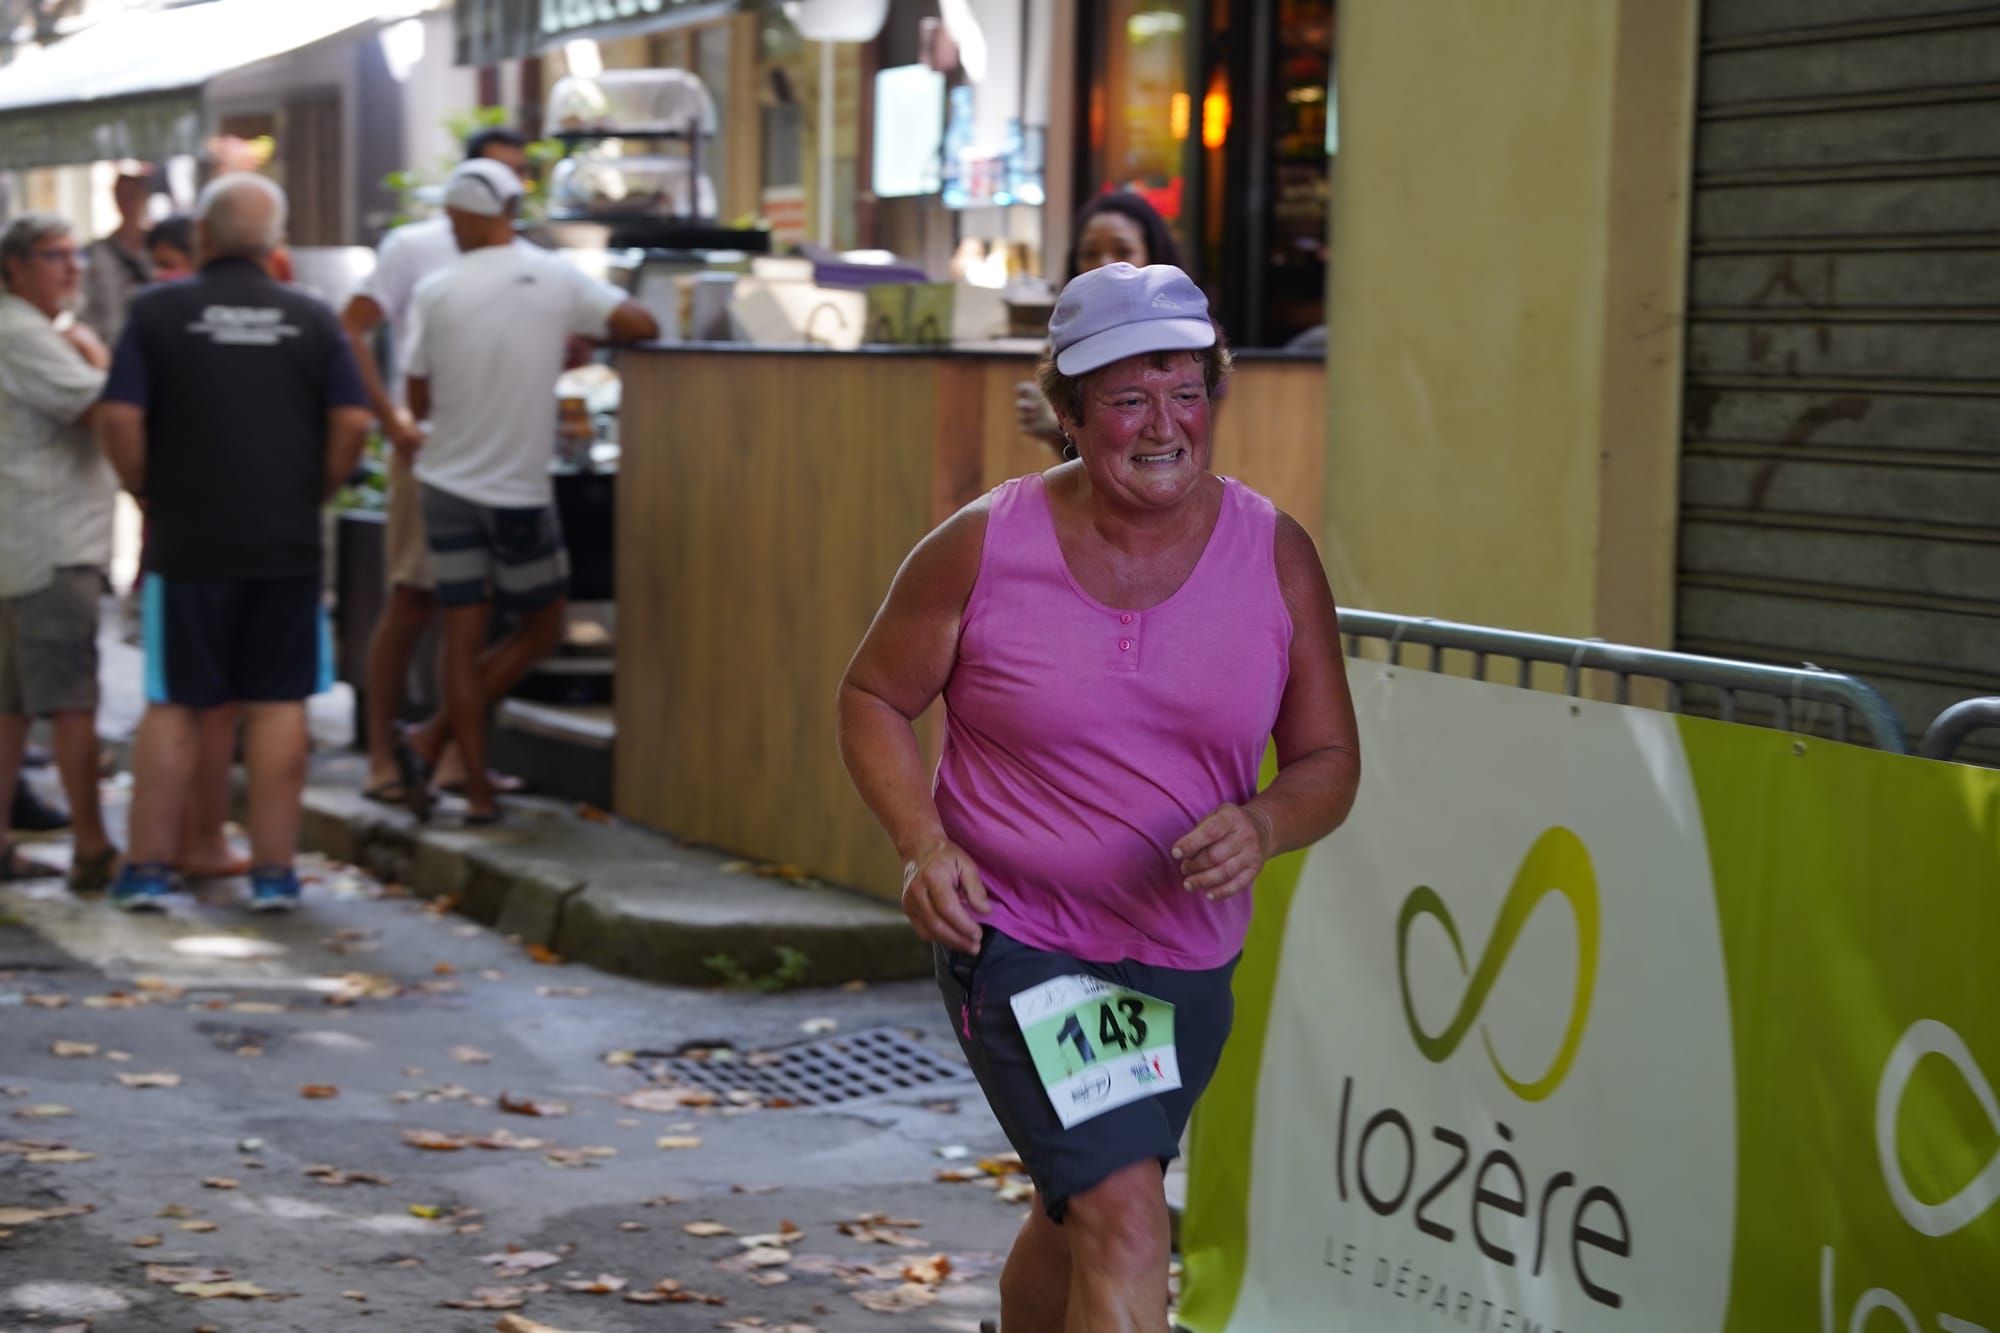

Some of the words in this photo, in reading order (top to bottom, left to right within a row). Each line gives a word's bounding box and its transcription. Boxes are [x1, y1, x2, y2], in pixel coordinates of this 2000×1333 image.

[1056, 997, 1148, 1067] 143
[1337, 1076, 1632, 1309] lozère
[1325, 1235, 1357, 1276] LE
[1373, 1256, 1564, 1333] DÉPARTE
